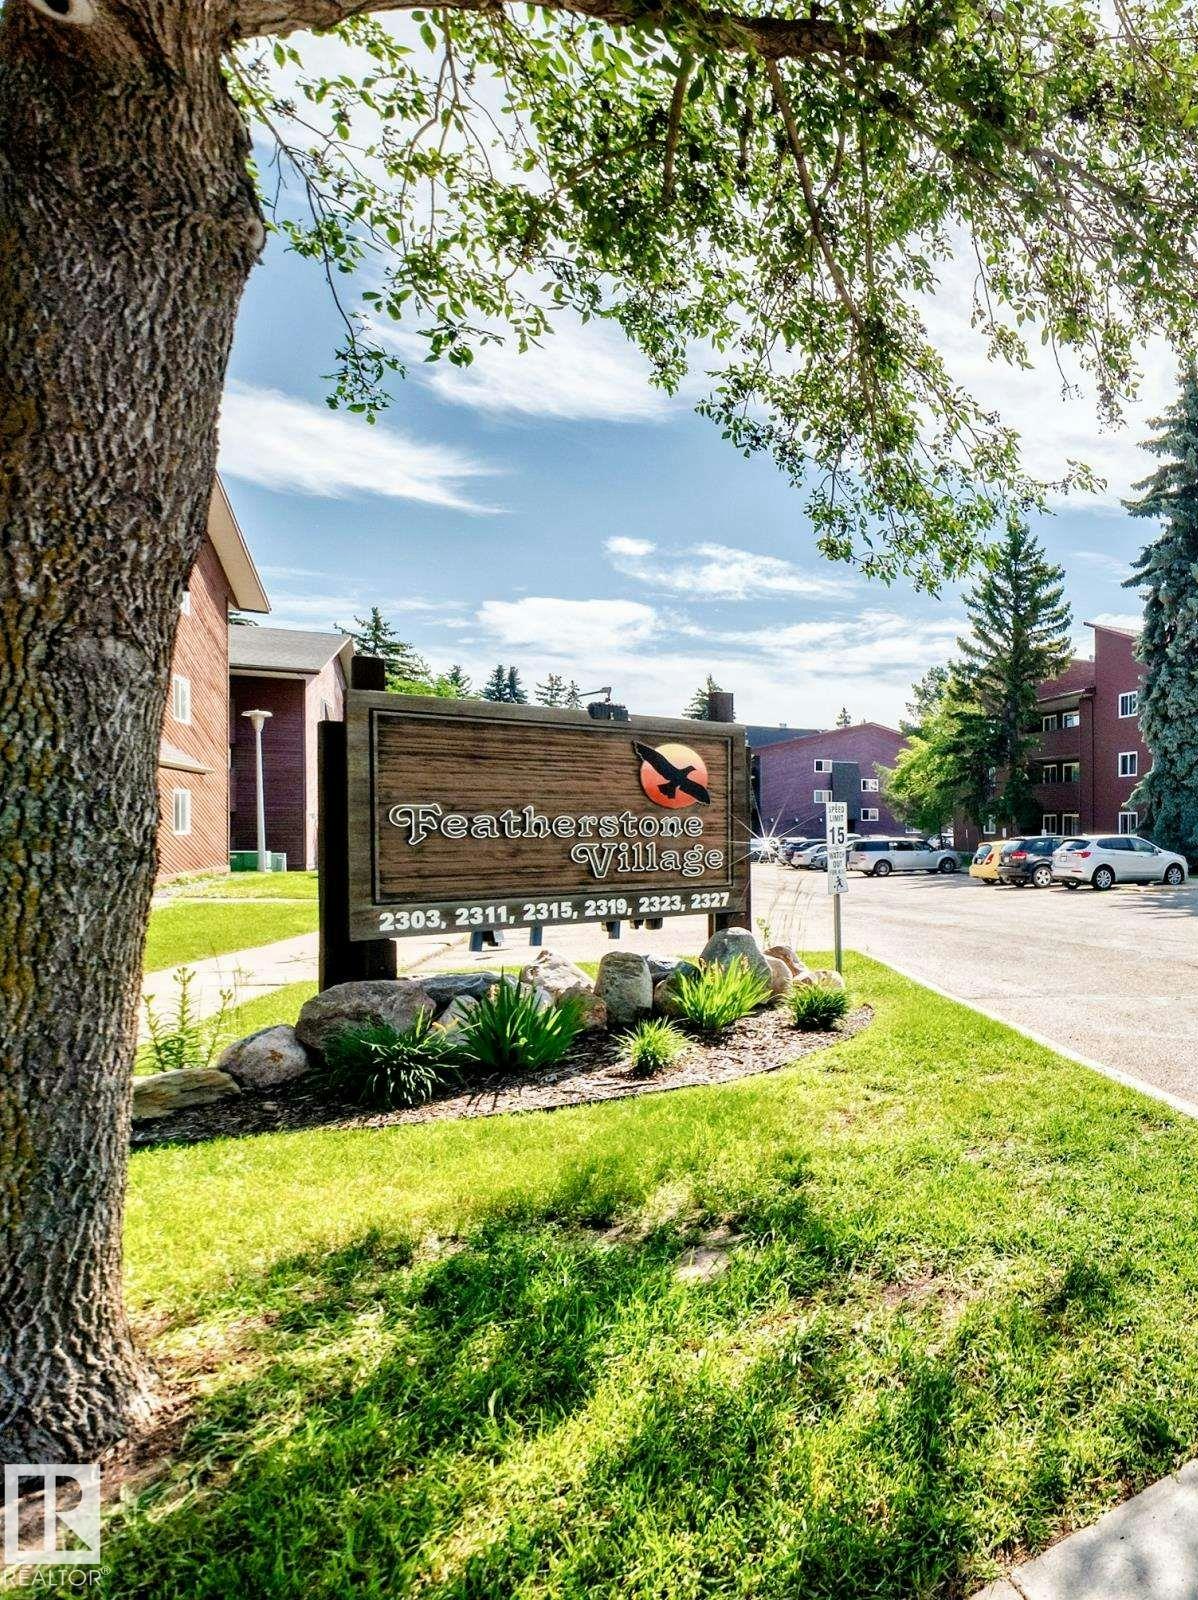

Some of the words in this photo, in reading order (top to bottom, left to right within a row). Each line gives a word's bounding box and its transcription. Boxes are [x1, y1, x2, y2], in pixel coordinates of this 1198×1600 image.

[829, 805, 844, 813] SPEED
[829, 814, 844, 822] LIMIT
[388, 802, 703, 846] Featherstone
[829, 826, 845, 844] 15
[571, 842, 724, 879] Village
[832, 860, 843, 869] OUT
[379, 908, 447, 931] 2303,
[455, 905, 515, 926] 2311,
[522, 901, 578, 921] 2315,
[584, 898, 632, 917] 2319,
[639, 895, 686, 913] 2323,
[691, 892, 730, 909] 2327
